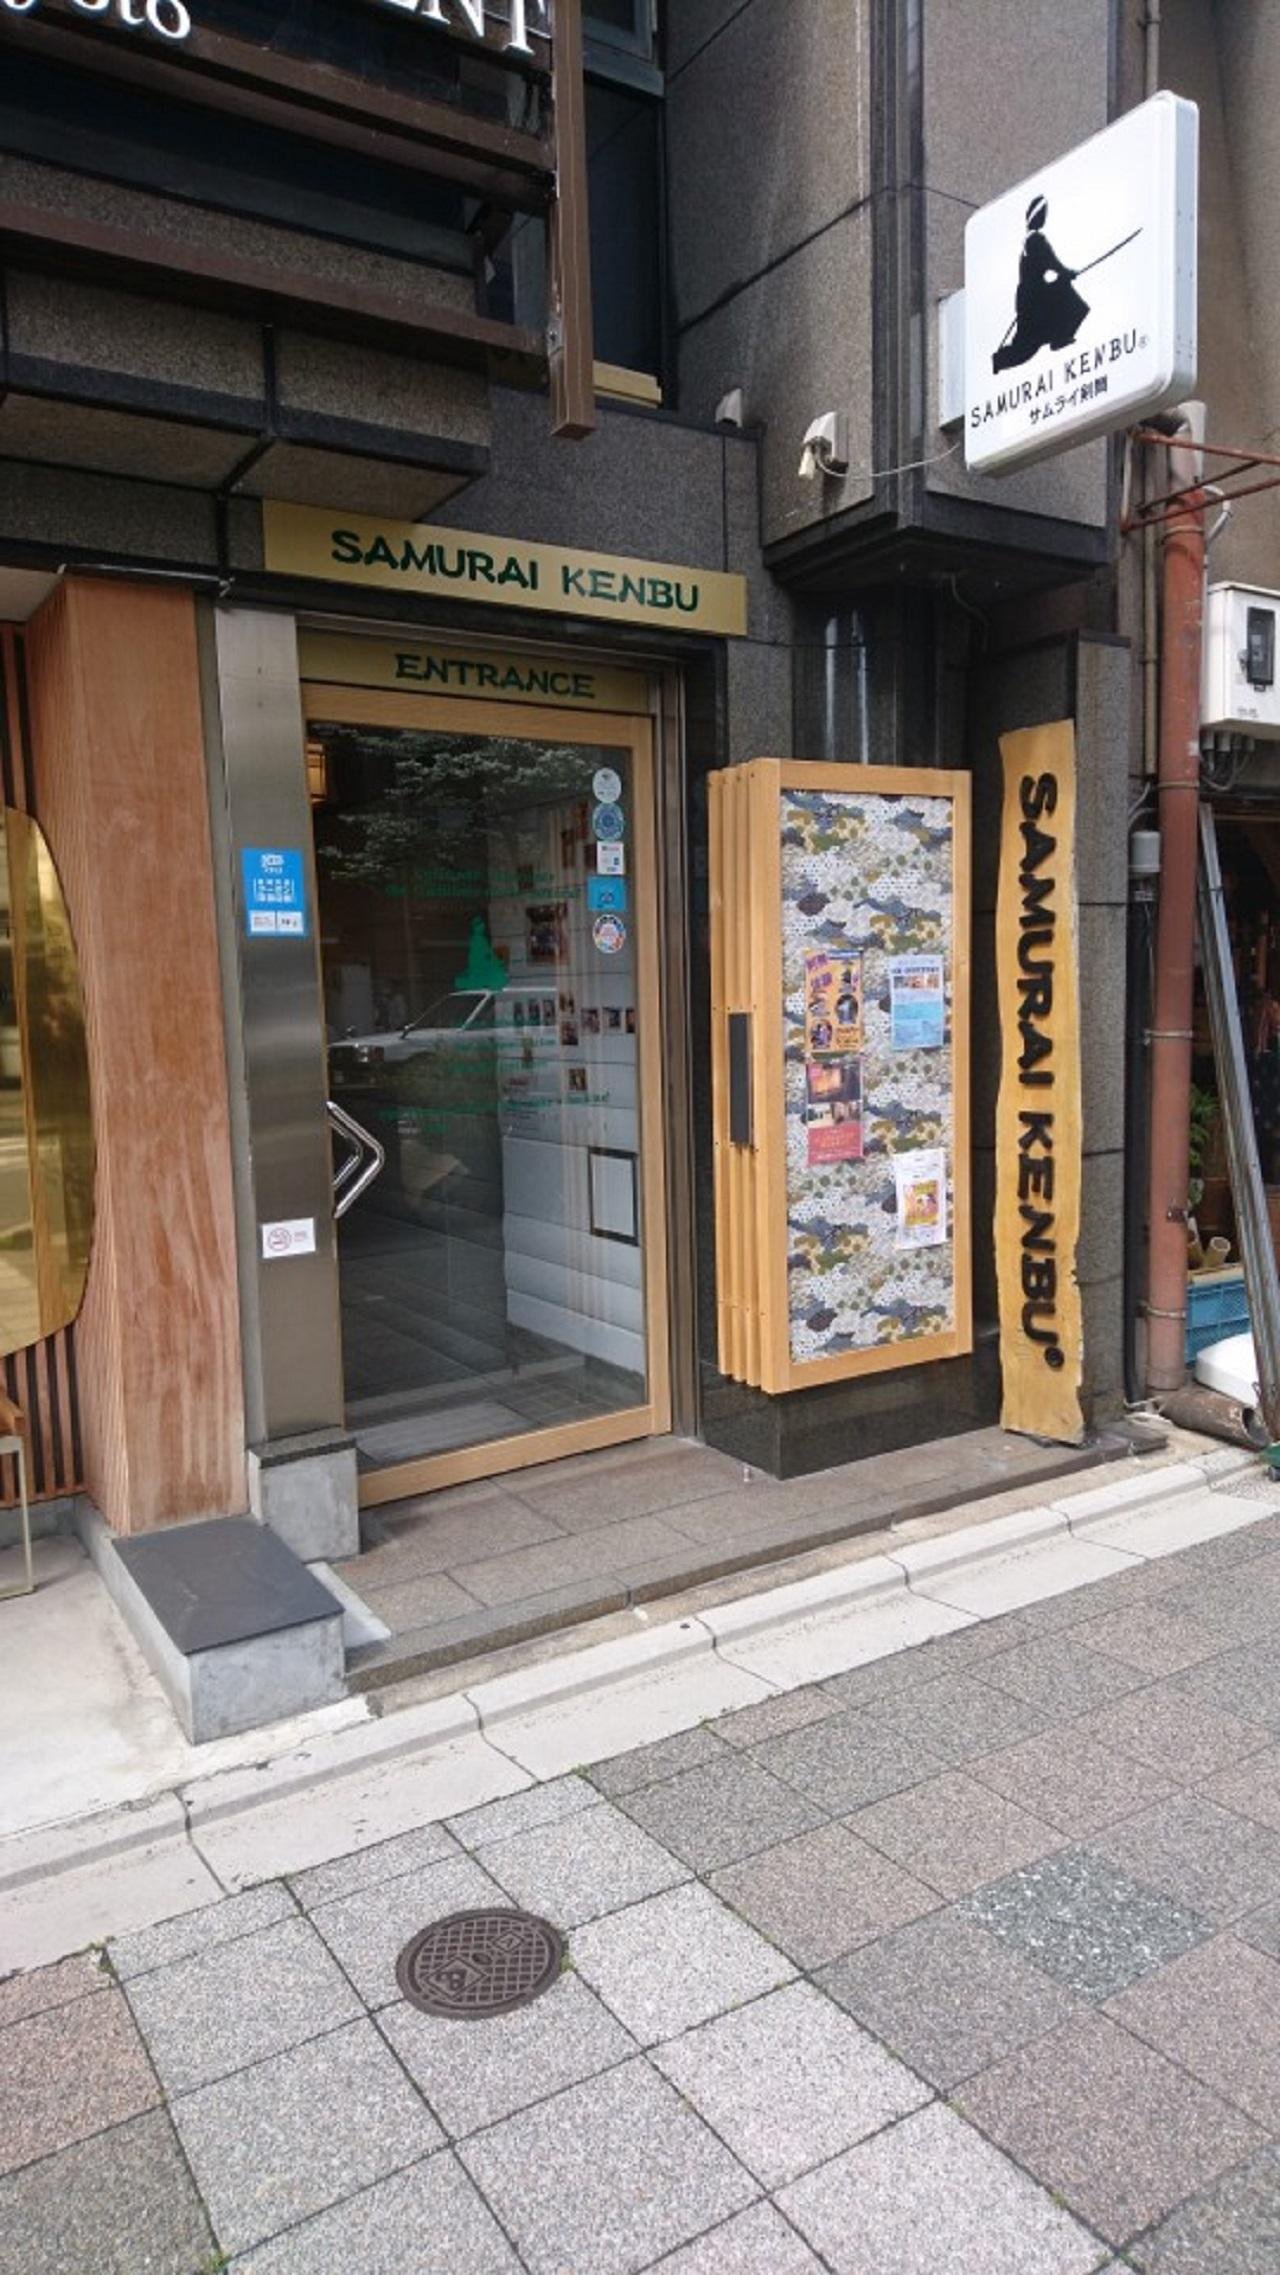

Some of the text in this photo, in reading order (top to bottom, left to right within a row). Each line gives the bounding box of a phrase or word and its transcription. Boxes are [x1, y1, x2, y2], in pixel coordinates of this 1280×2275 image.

[971, 369, 1053, 428] SAMURAI
[331, 530, 699, 612] SAMURAI KENBU
[394, 653, 596, 699] ENTRANCE
[1017, 772, 1058, 1085] SAMURAI
